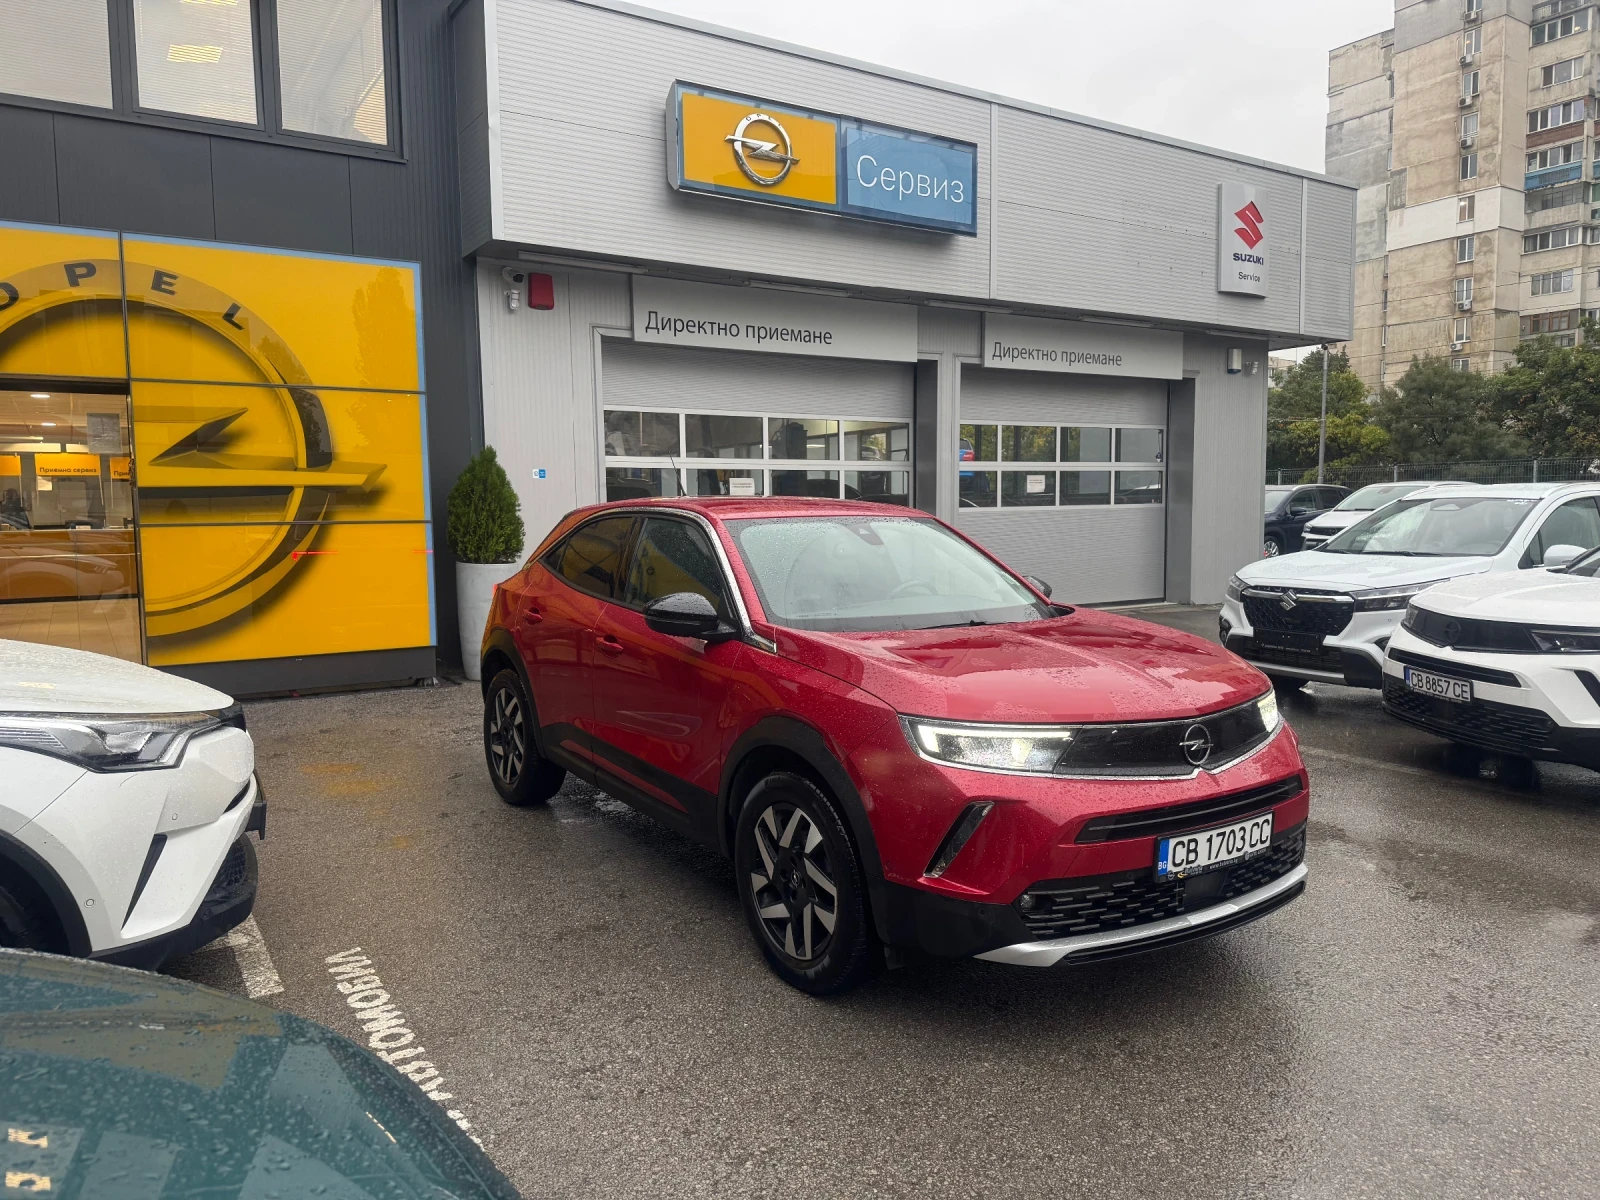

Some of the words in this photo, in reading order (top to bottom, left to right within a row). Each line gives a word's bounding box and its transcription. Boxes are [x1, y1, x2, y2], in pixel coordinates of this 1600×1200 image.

[857, 154, 964, 203] Сервиз
[1232, 252, 1264, 266] SUZUKI
[1238, 271, 1261, 282] Service
[645, 310, 740, 338] Директно
[745, 324, 833, 345] приемане
[992, 341, 1057, 363] Директно
[1061, 350, 1122, 366] приемане
[1411, 672, 1424, 688] CB
[1425, 676, 1451, 695] 8857
[1453, 682, 1469, 700] CE
[1172, 838, 1199, 868] CB
[1206, 826, 1247, 861] 1703
[1249, 818, 1270, 848] CC
[1158, 861, 1167, 870] BG
